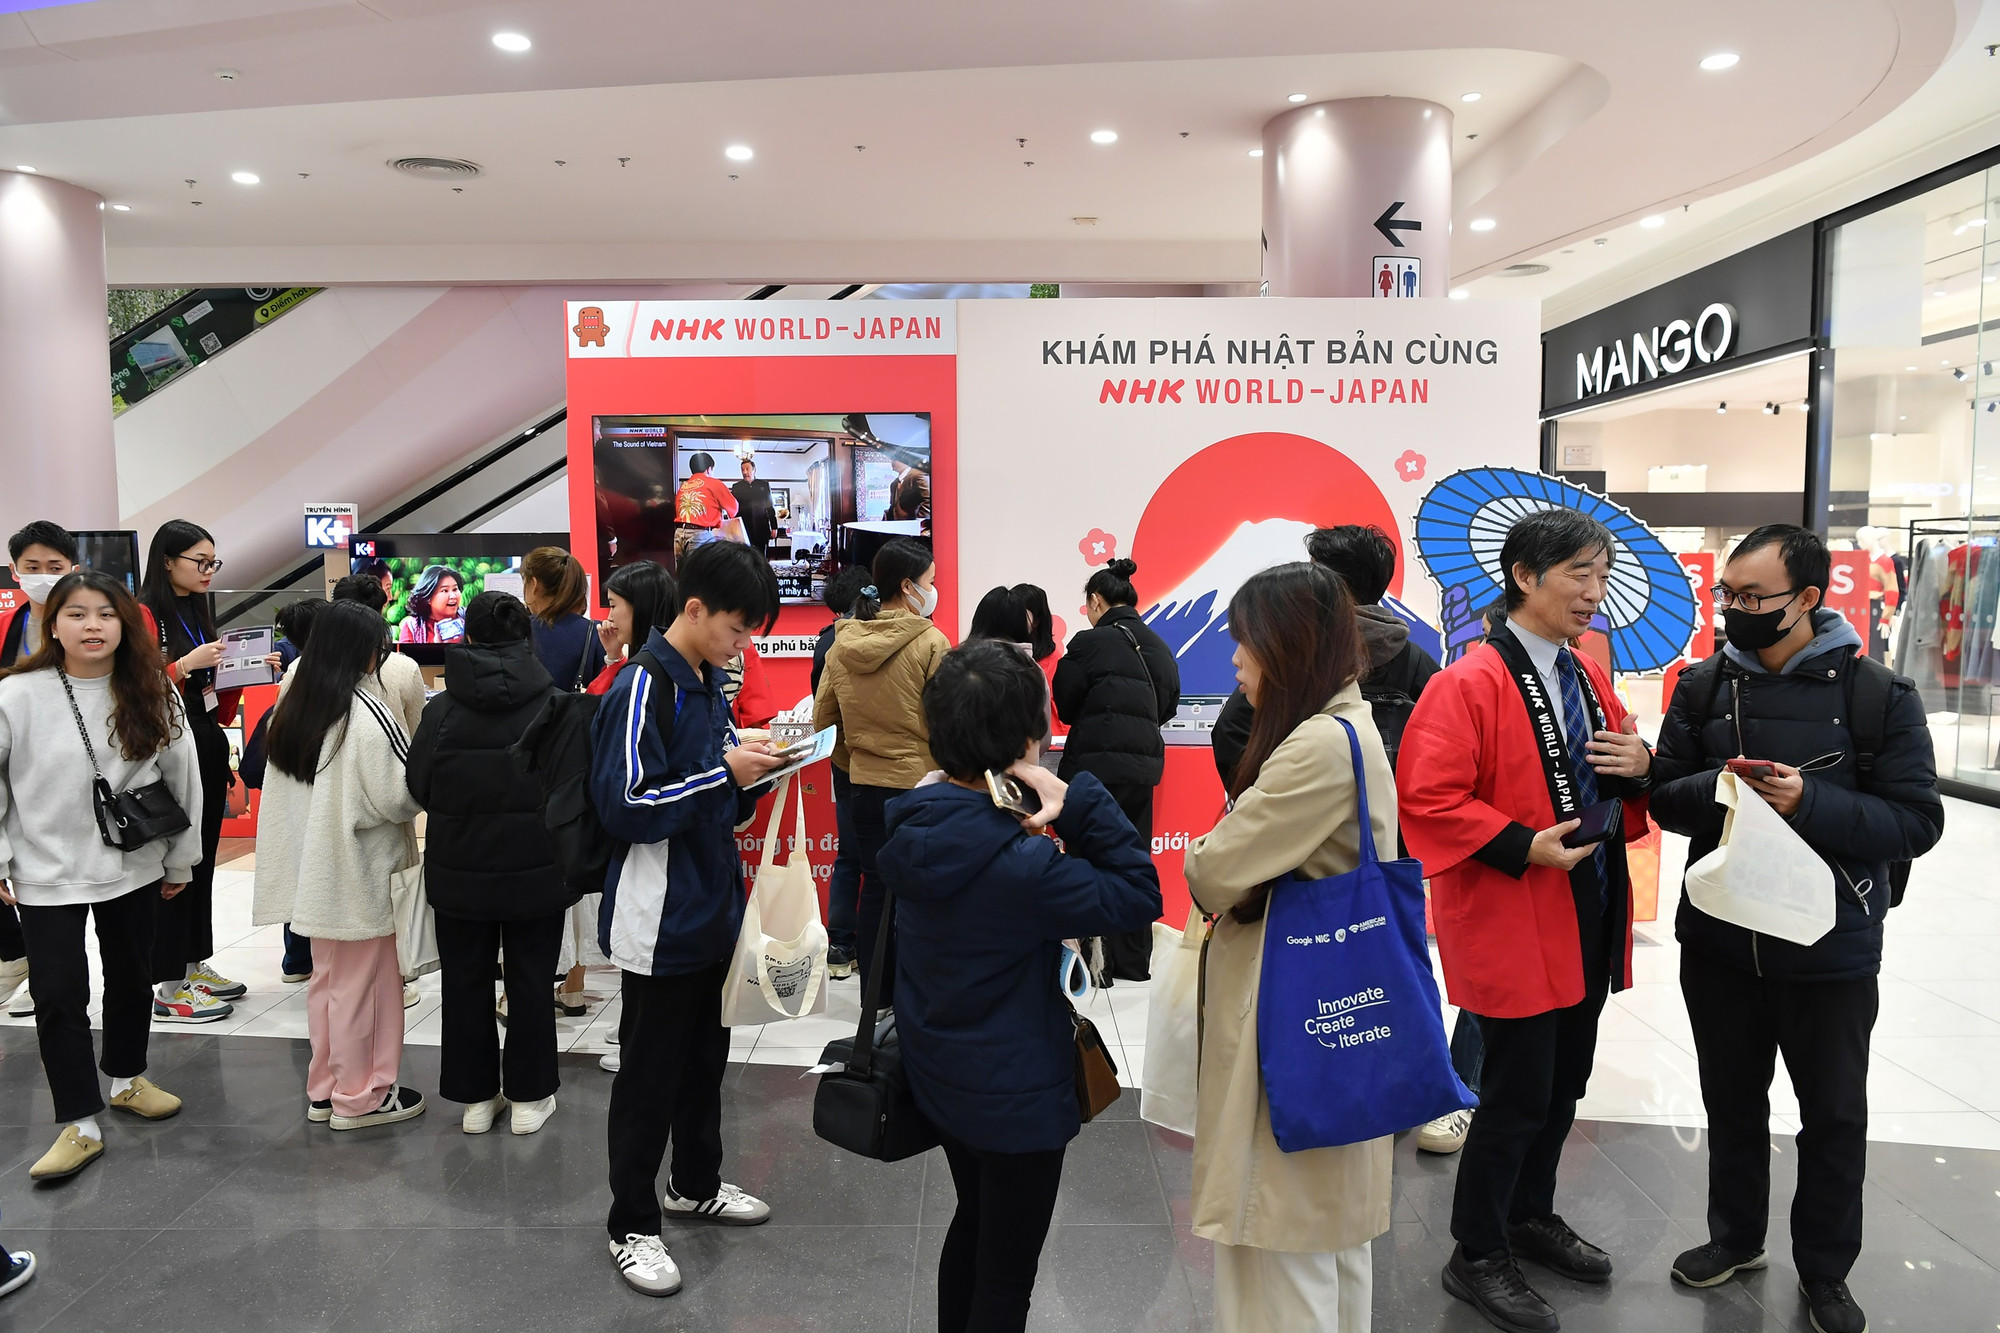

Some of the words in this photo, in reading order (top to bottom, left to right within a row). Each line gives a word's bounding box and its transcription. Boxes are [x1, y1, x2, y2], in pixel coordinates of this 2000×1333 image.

[650, 318, 726, 341] NHK
[1042, 333, 1136, 365] KHÁM
[1149, 333, 1216, 365] PHÁ
[1227, 333, 1315, 370] NHẬT
[1327, 329, 1393, 364] BẢN
[1405, 333, 1498, 365] CÙNG
[1577, 302, 1733, 400] MANGO
[1098, 378, 1185, 404] NHK
[754, 642, 769, 653] ng
[773, 640, 795, 653] phú
[800, 637, 815, 651] bằ
[1522, 673, 1545, 709] NHK
[1151, 832, 1190, 855] giới
[1359, 916, 1386, 928] AMERICAN
[1287, 936, 1313, 946] Google
[1315, 933, 1330, 944] NIC
[1318, 987, 1384, 1014] Innovate
[1304, 1015, 1355, 1035] Create
[1338, 1025, 1391, 1048] Iterate
